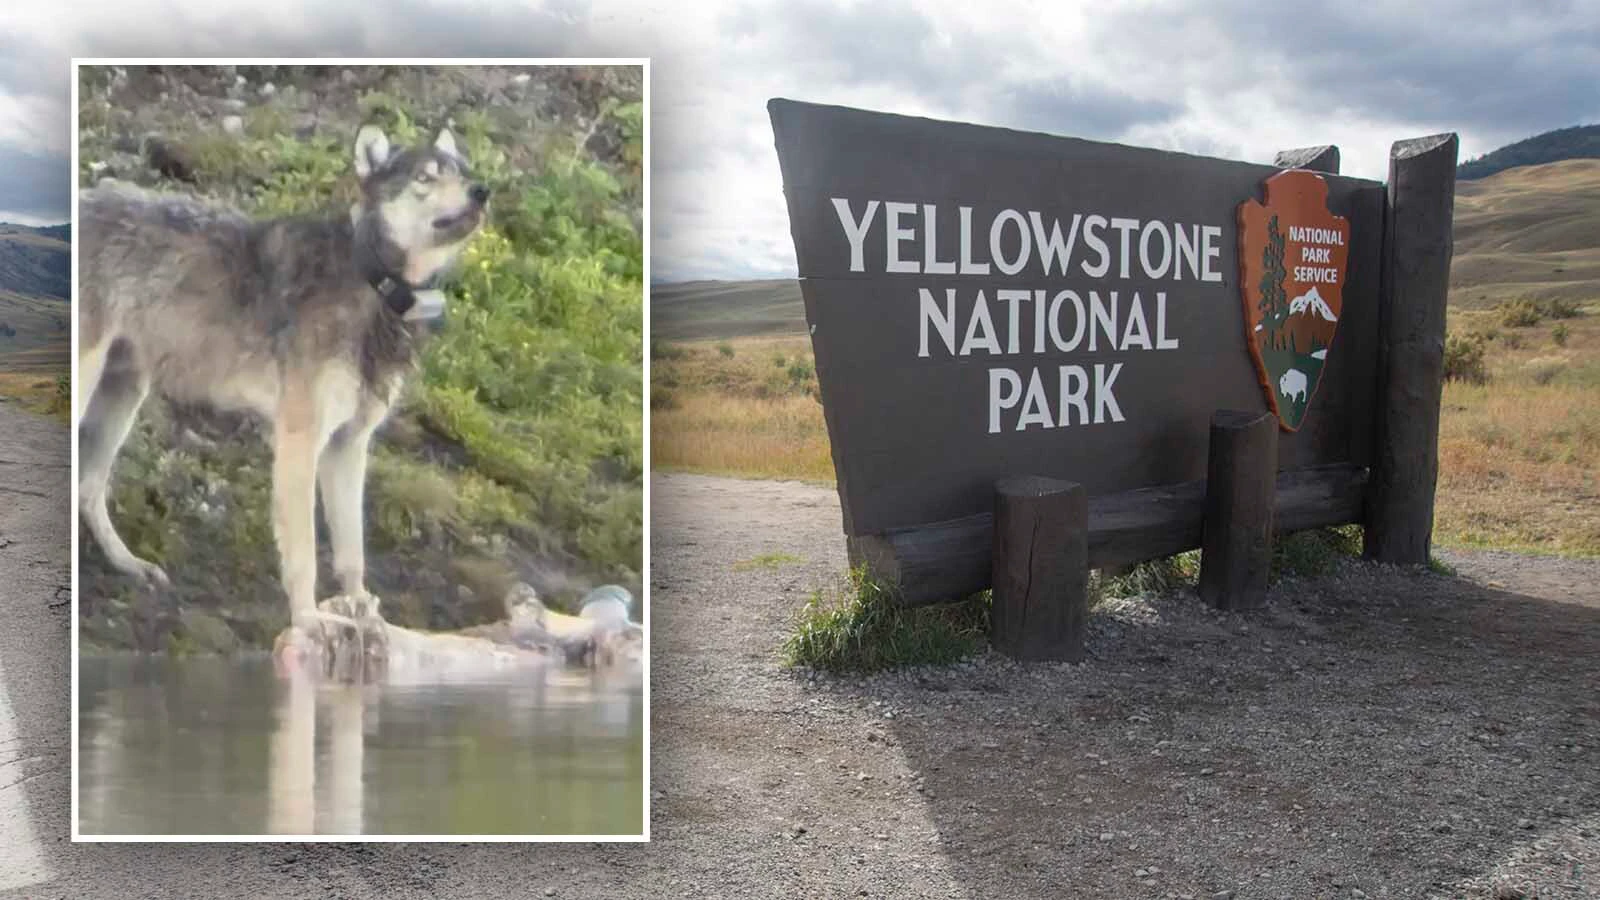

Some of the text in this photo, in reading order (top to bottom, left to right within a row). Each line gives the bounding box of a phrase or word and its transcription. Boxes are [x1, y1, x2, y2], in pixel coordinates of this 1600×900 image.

[830, 197, 1222, 283] YELLOWSTONE
[1289, 226, 1344, 245] NATIONAL
[1302, 247, 1330, 263] PARK
[1294, 266, 1337, 283] SERVICE
[919, 289, 1179, 357] NATIONAL
[988, 362, 1125, 434] PARK
